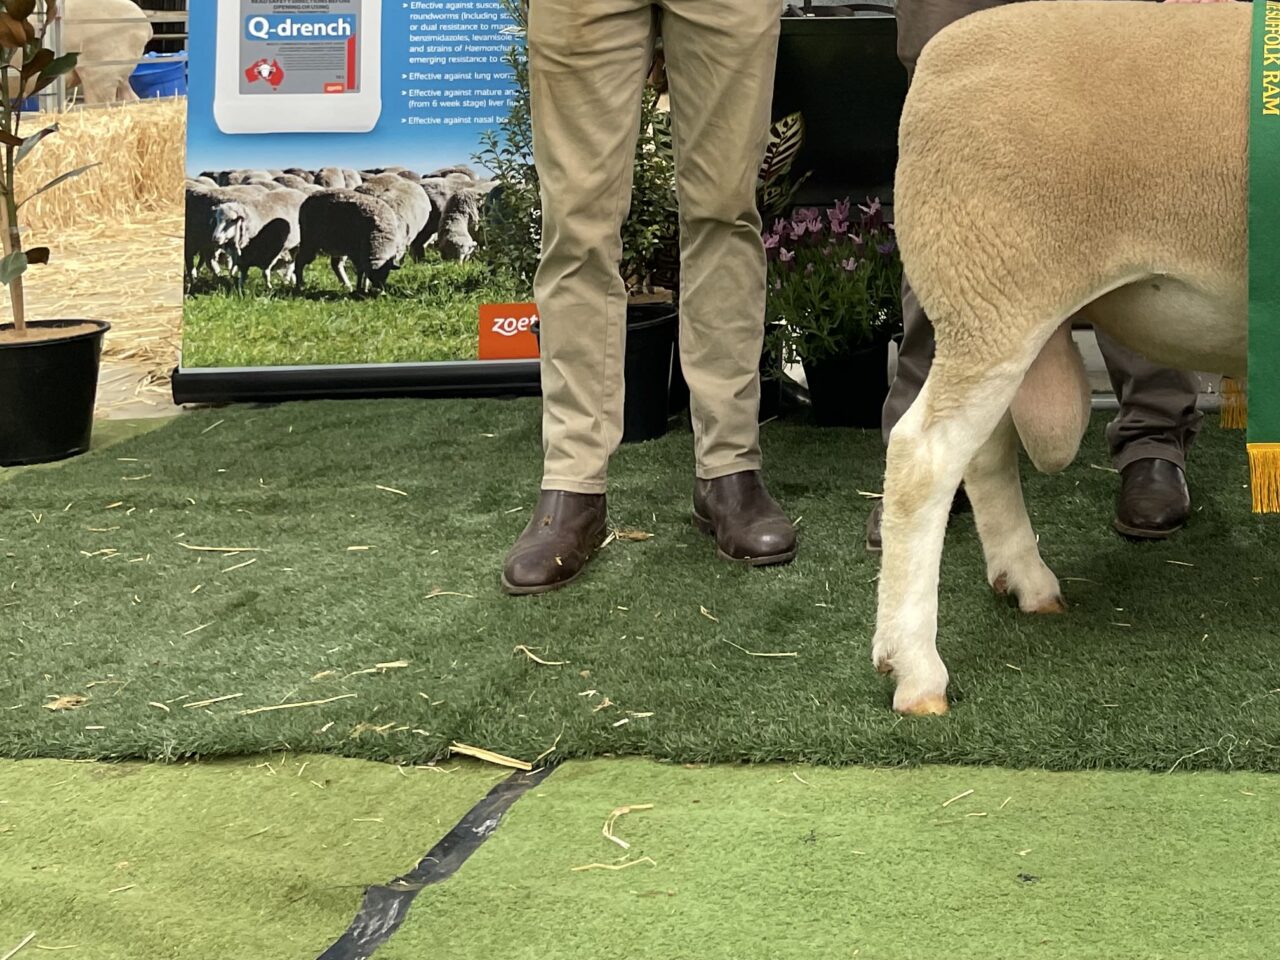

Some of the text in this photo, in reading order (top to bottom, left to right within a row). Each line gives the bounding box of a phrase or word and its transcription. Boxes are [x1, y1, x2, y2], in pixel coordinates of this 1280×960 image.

[411, 1, 443, 9] Effective
[446, 2, 473, 11] against
[410, 12, 459, 20] roundworms
[248, 16, 351, 39] Q-drench
[448, 55, 487, 63] resistance
[409, 72, 441, 80] Effective
[444, 72, 472, 81] against
[474, 72, 491, 80] lung
[409, 89, 441, 97] Effective
[444, 89, 471, 98] against
[1263, 71, 1280, 115] RAM
[463, 100, 486, 108] stage)
[443, 117, 471, 125] against
